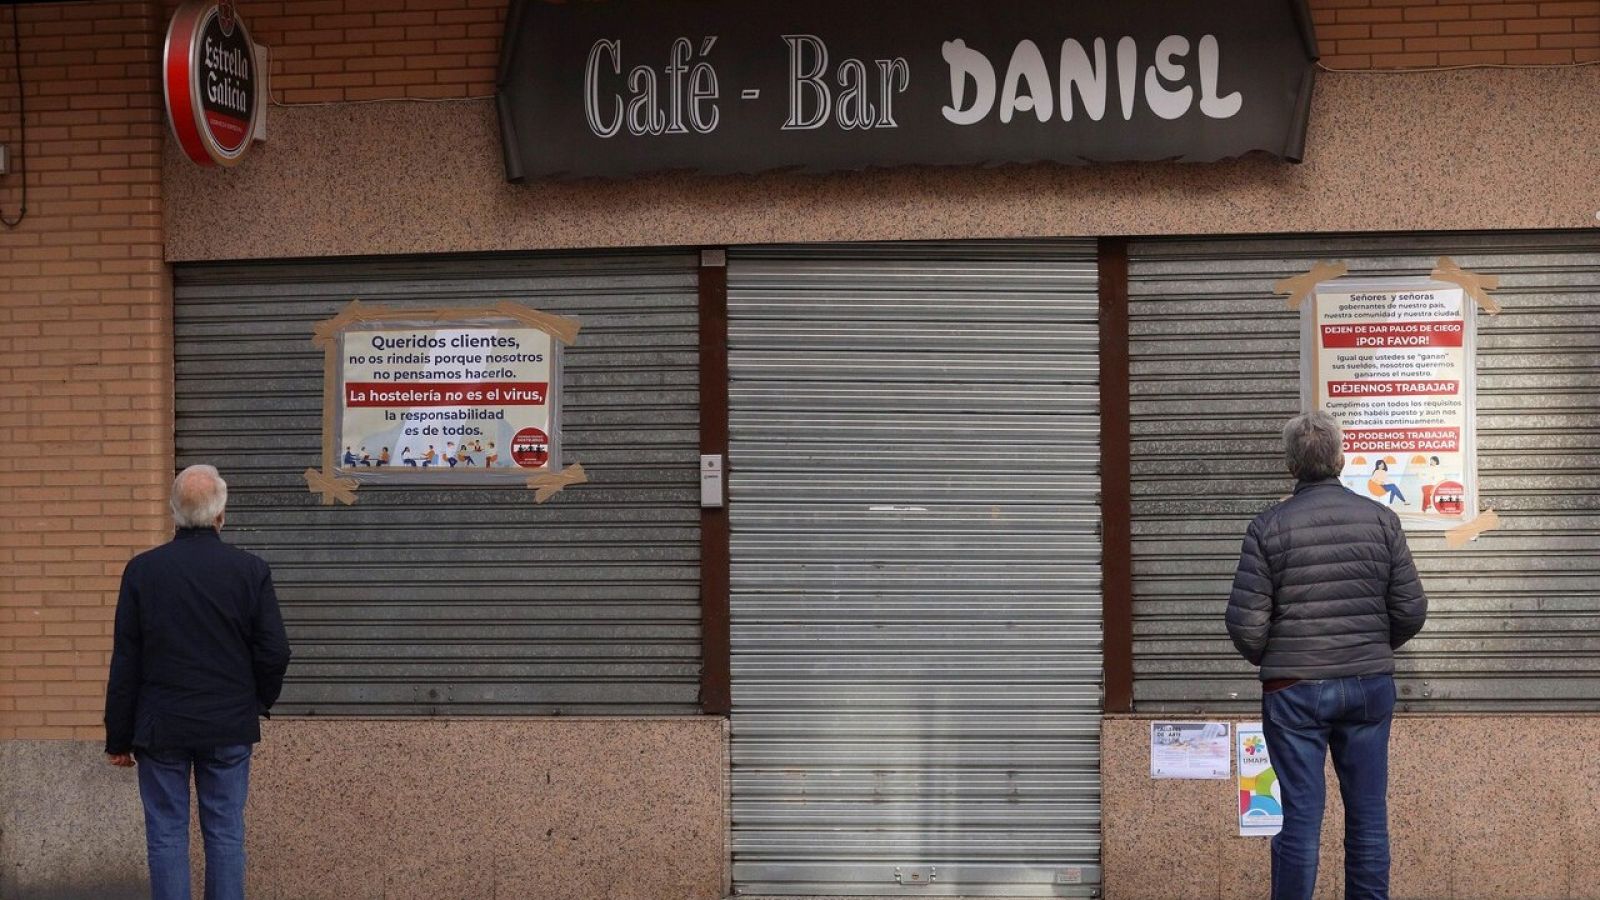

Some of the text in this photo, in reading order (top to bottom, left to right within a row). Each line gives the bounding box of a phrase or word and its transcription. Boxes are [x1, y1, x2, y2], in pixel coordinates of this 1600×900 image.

[205, 36, 249, 80] Estrella
[583, 34, 1243, 138] Café - Bar DANIEL
[207, 71, 246, 112] Galicia
[1350, 293, 1386, 302] Señores
[1398, 293, 1434, 301] señoras
[1339, 303, 1385, 312] gobernantes
[1324, 326, 1353, 334] DEJEN
[1389, 325, 1418, 333] PALOS
[1434, 324, 1461, 332] CIEGO
[371, 333, 520, 350] Queridos clientes,
[1356, 336, 1430, 346] ¡POR FAVOR!
[349, 352, 543, 366] no os rindais porque nosotros
[1337, 354, 1357, 363] Igual
[1358, 355, 1373, 363] que
[1347, 362, 1379, 370] sueldos,
[1415, 362, 1454, 370] queremos
[373, 368, 516, 382] no pensamos hacerlo.
[1354, 371, 1390, 379] ganarnos
[1333, 381, 1455, 394] DÉJENNOS TRABAJAR
[350, 388, 543, 402] La hostelería no es el virus,
[1326, 401, 1369, 410] Cumplimos
[1423, 400, 1462, 408] requisitos
[384, 408, 504, 422] la responsabilidad
[1391, 410, 1417, 418] puesto
[404, 424, 483, 436] es de todos.
[1359, 432, 1405, 440] PODEMOS
[1406, 431, 1457, 440] TRABAJAR,
[1353, 441, 1415, 450] PODREMOS
[1418, 440, 1456, 449] PAGAR
